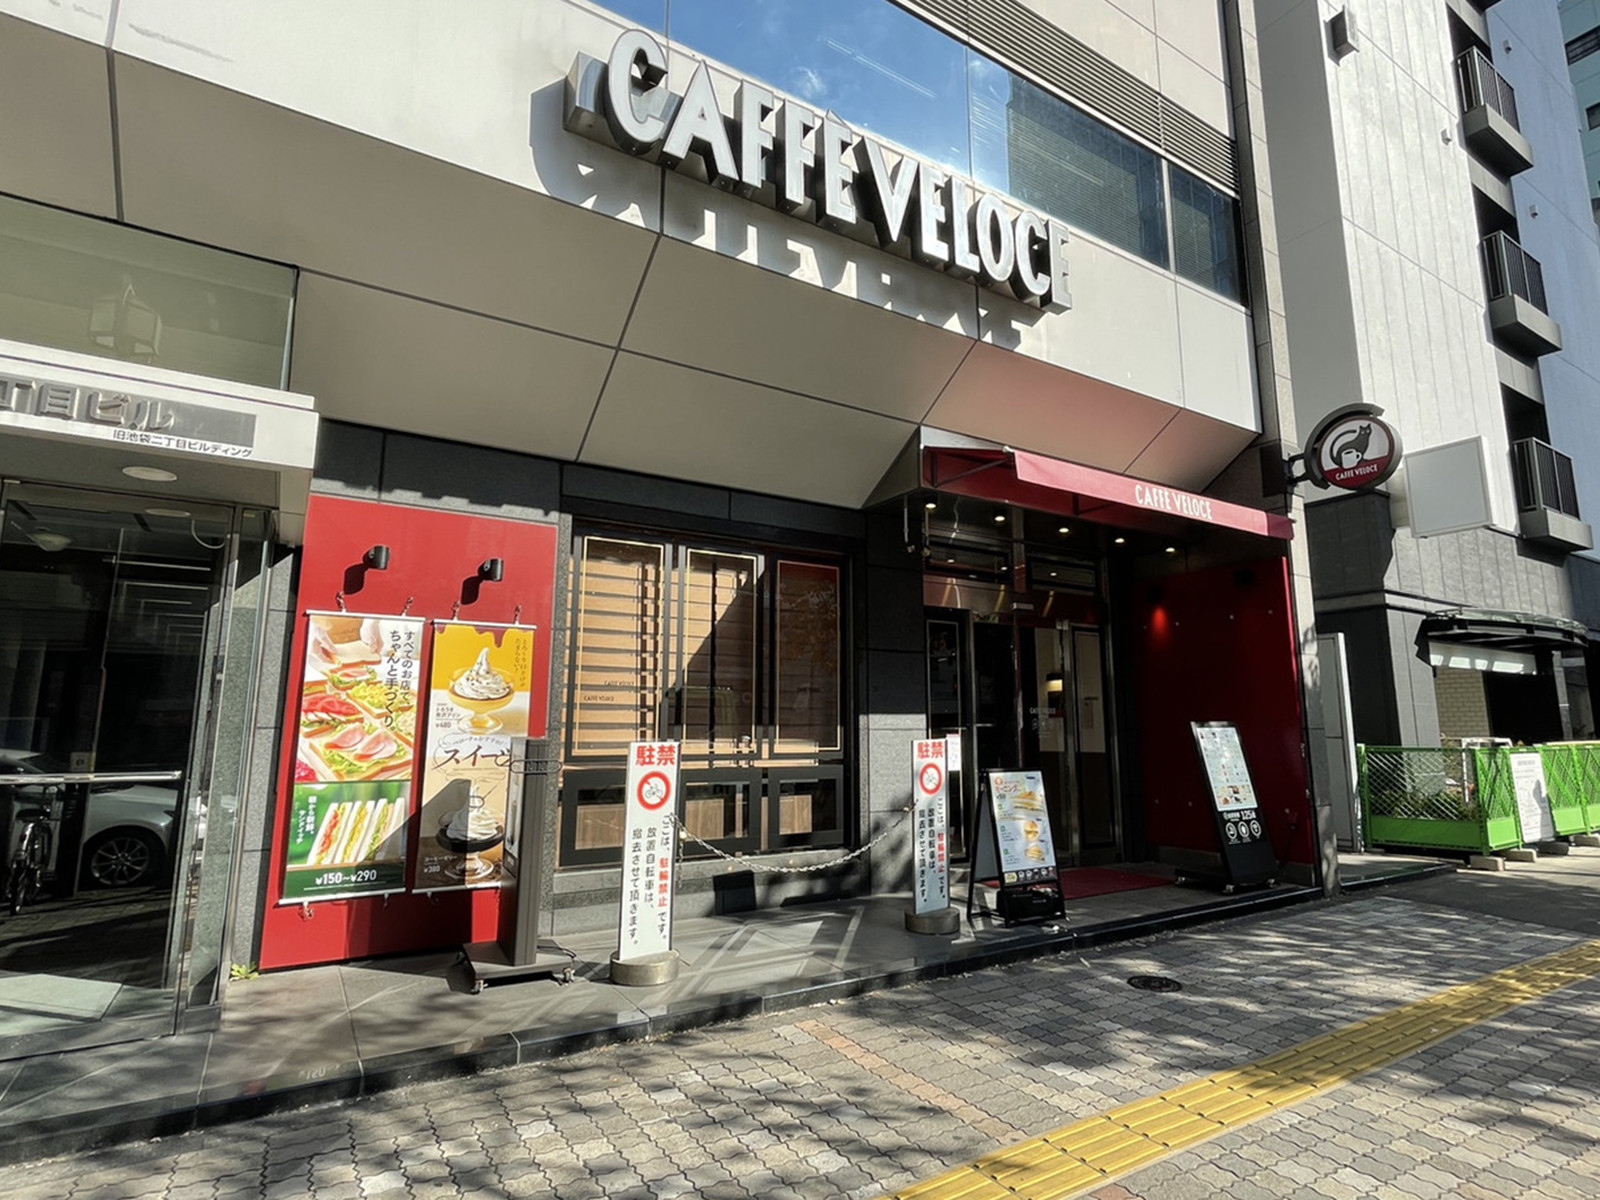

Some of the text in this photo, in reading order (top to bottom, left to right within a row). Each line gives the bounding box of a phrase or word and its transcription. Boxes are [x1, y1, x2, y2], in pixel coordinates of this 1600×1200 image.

[863, 136, 1072, 310] VELOCE
[113, 429, 252, 457] 旧池袋二丁目ビルディング
[1171, 491, 1213, 520] VELOCE
[384, 630, 402, 731] ちゃんと手づくり。
[635, 745, 676, 766] 駐禁
[917, 741, 944, 759] 駐禁
[628, 827, 643, 944] 撤去させて頂きます。
